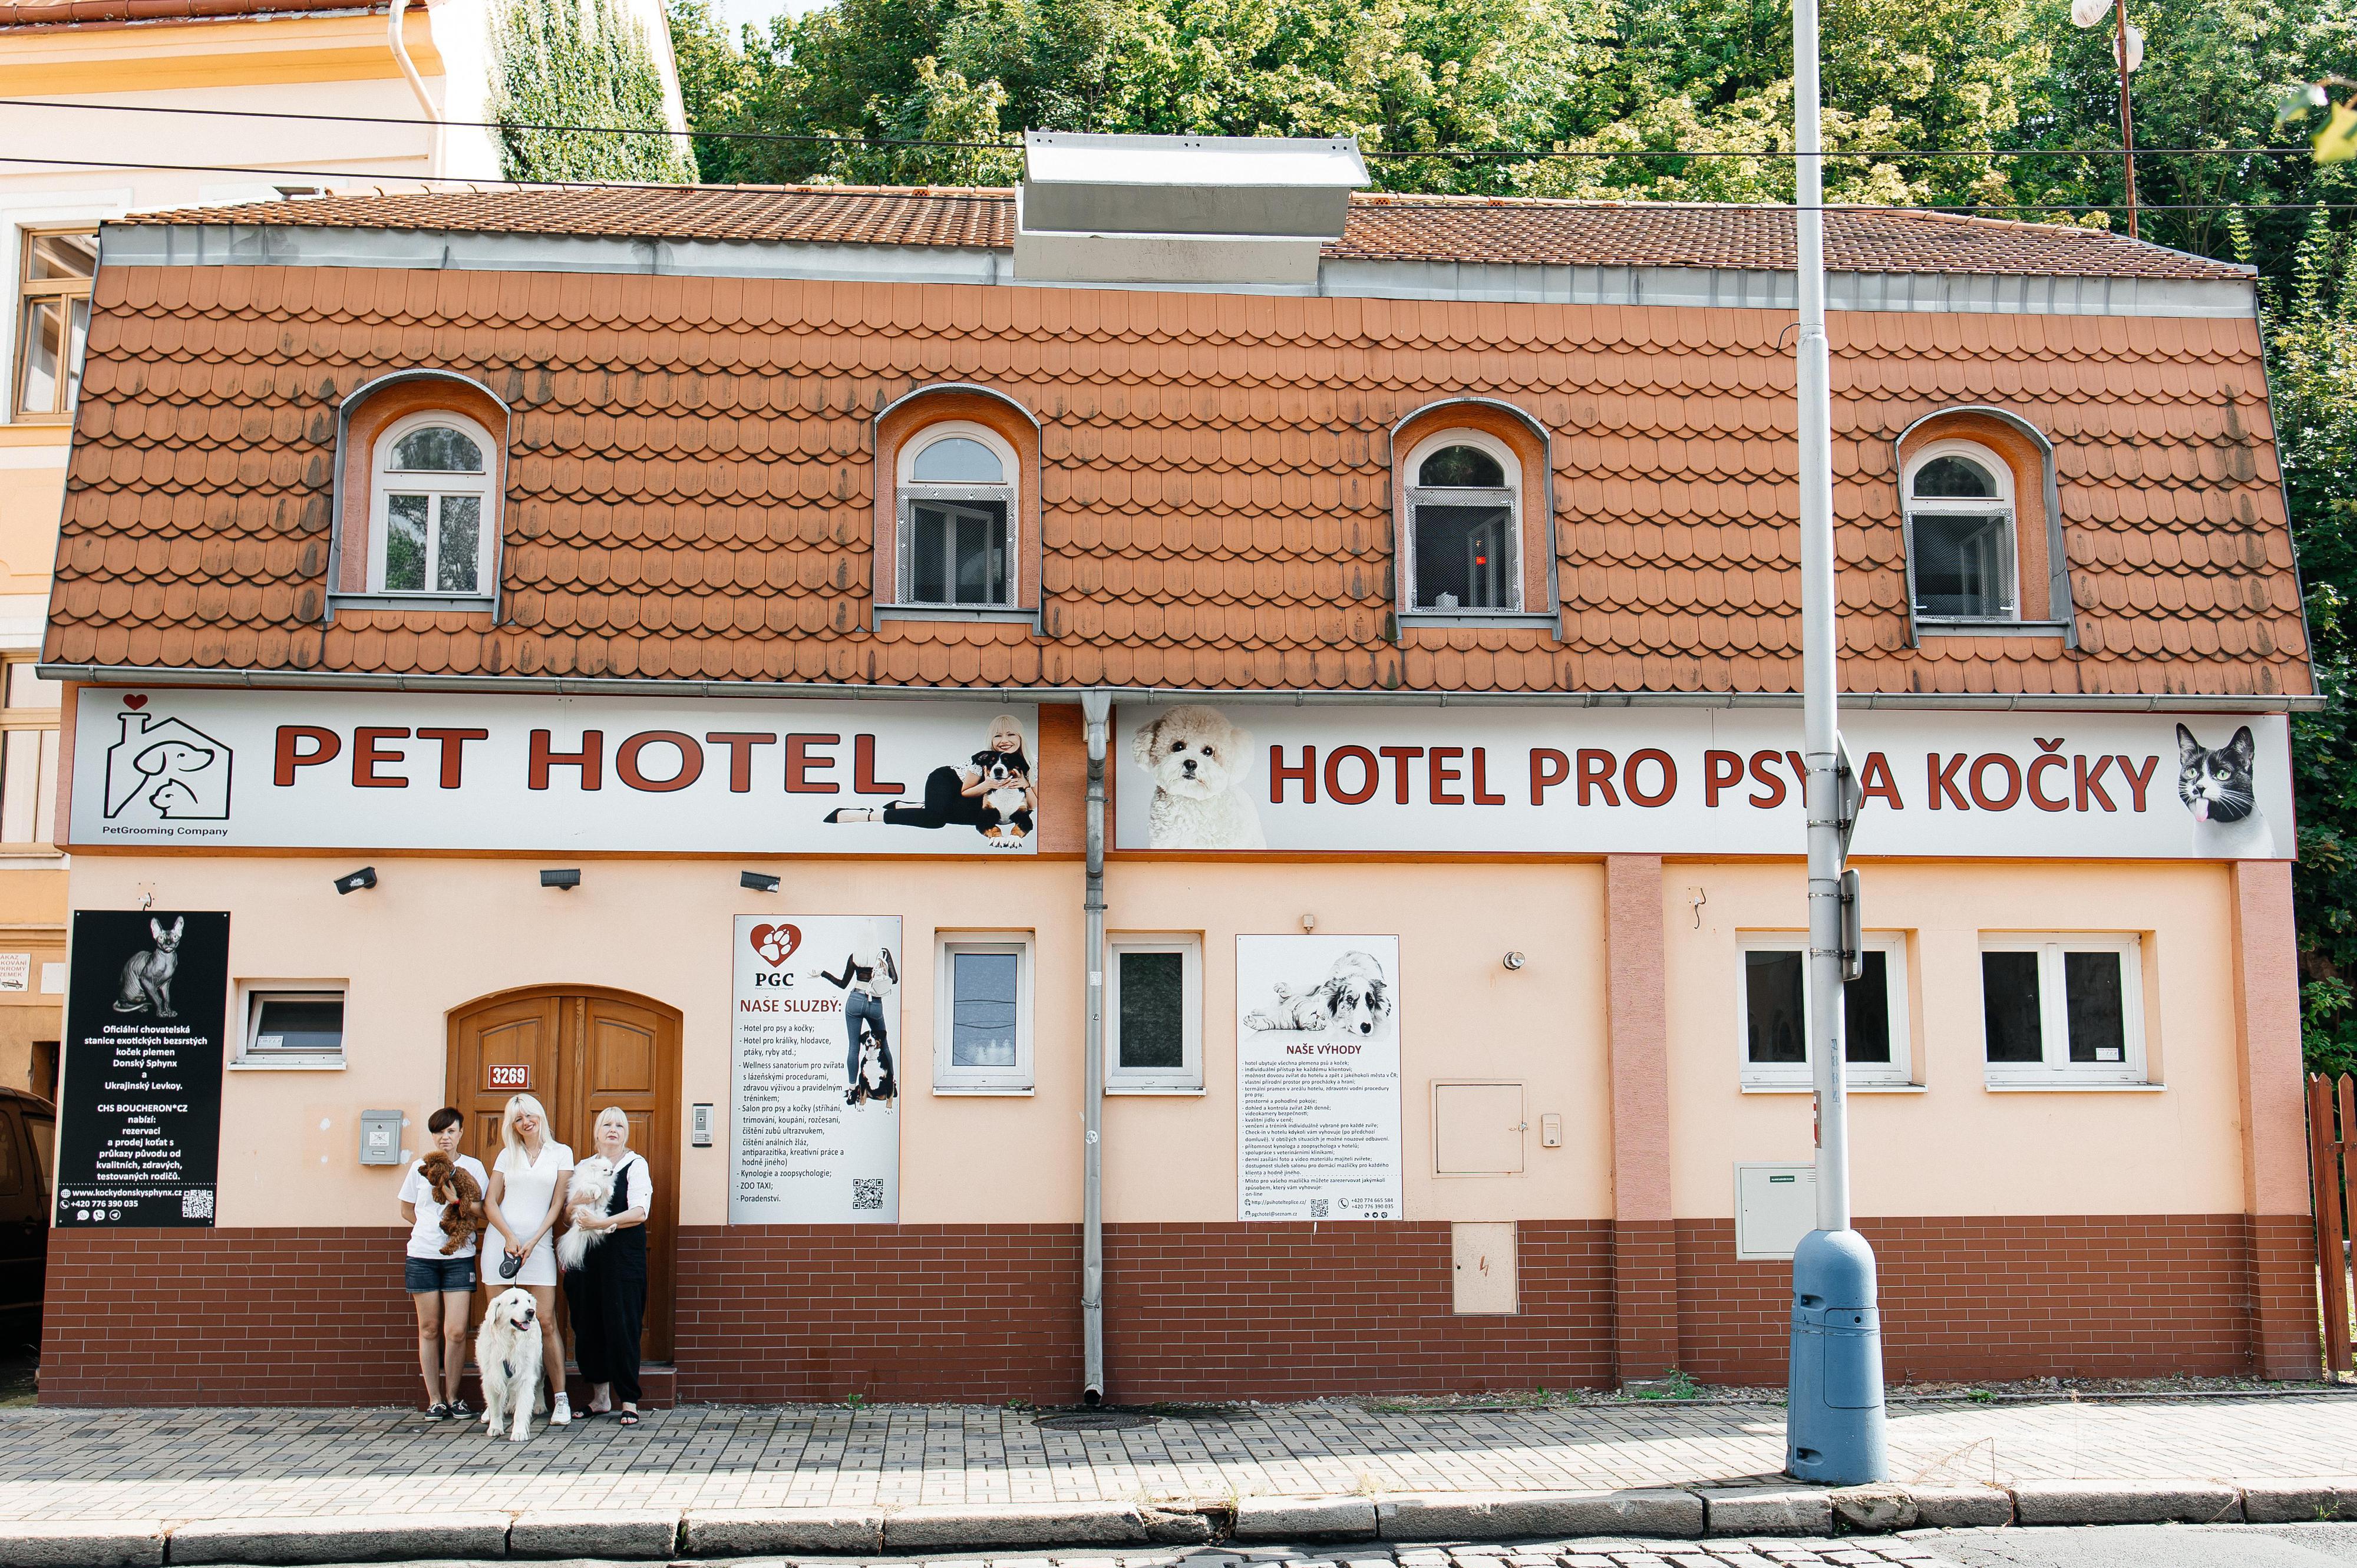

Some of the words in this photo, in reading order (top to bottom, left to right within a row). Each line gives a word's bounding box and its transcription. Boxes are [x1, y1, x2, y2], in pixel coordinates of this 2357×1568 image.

[273, 725, 489, 789] PET
[528, 729, 906, 794] HOTEL
[1269, 744, 1506, 806] HOTEL
[1529, 748, 1678, 808] PRO
[1860, 752, 1904, 810] A
[1927, 737, 2160, 812] KOČKY
[103, 826, 174, 836] PetGrooming
[177, 827, 228, 837] Company
[755, 973, 794, 986] PGC
[740, 995, 779, 1012] NAŠE
[794, 1024, 814, 1033] kočky;
[117, 1036, 161, 1046] exotických
[164, 1036, 207, 1046] bezsrstých
[776, 1036, 798, 1045] králíky,
[143, 1048, 174, 1057] plemen
[744, 1048, 763, 1057] ptáky,
[765, 1048, 780, 1057] ryby
[1287, 1043, 1314, 1054] NAŠE
[1317, 1043, 1361, 1054] VÝHODY
[113, 1059, 144, 1068] Donský
[146, 1059, 177, 1068] Sphynx
[493, 1067, 525, 1084] 3269
[748, 1072, 784, 1081] lázeňskými
[786, 1073, 828, 1081] procedurami,
[105, 1082, 150, 1091] Ukrajinský
[151, 1082, 182, 1091] Levkoy.
[771, 1084, 794, 1092] výživou
[803, 1084, 842, 1092] pravidelným
[744, 1094, 779, 1102] tréninkem;
[793, 1104, 811, 1113] kočky
[813, 1104, 841, 1113] (stříhání,
[743, 1116, 776, 1124] trimování,
[778, 1116, 806, 1124] koupání,
[783, 1127, 824, 1135] ultrazvukem,
[115, 1138, 143, 1147] prodej
[795, 1138, 808, 1147] žláz,
[99, 1149, 133, 1158] průkazy
[135, 1149, 167, 1158] původu
[742, 1148, 788, 1157] antiparazitika,
[821, 1148, 838, 1157] práce
[97, 1161, 140, 1170] kvalitních,
[143, 1161, 182, 1170] zdravých,
[764, 1158, 787, 1167] jiného)
[97, 1172, 148, 1181] testovaných
[741, 1170, 773, 1179] Kynologie
[780, 1170, 831, 1178] zoopsychologie;
[757, 1182, 773, 1190] TAXI;
[72, 1189, 182, 1198] www.kockydonskysphynx.cz
